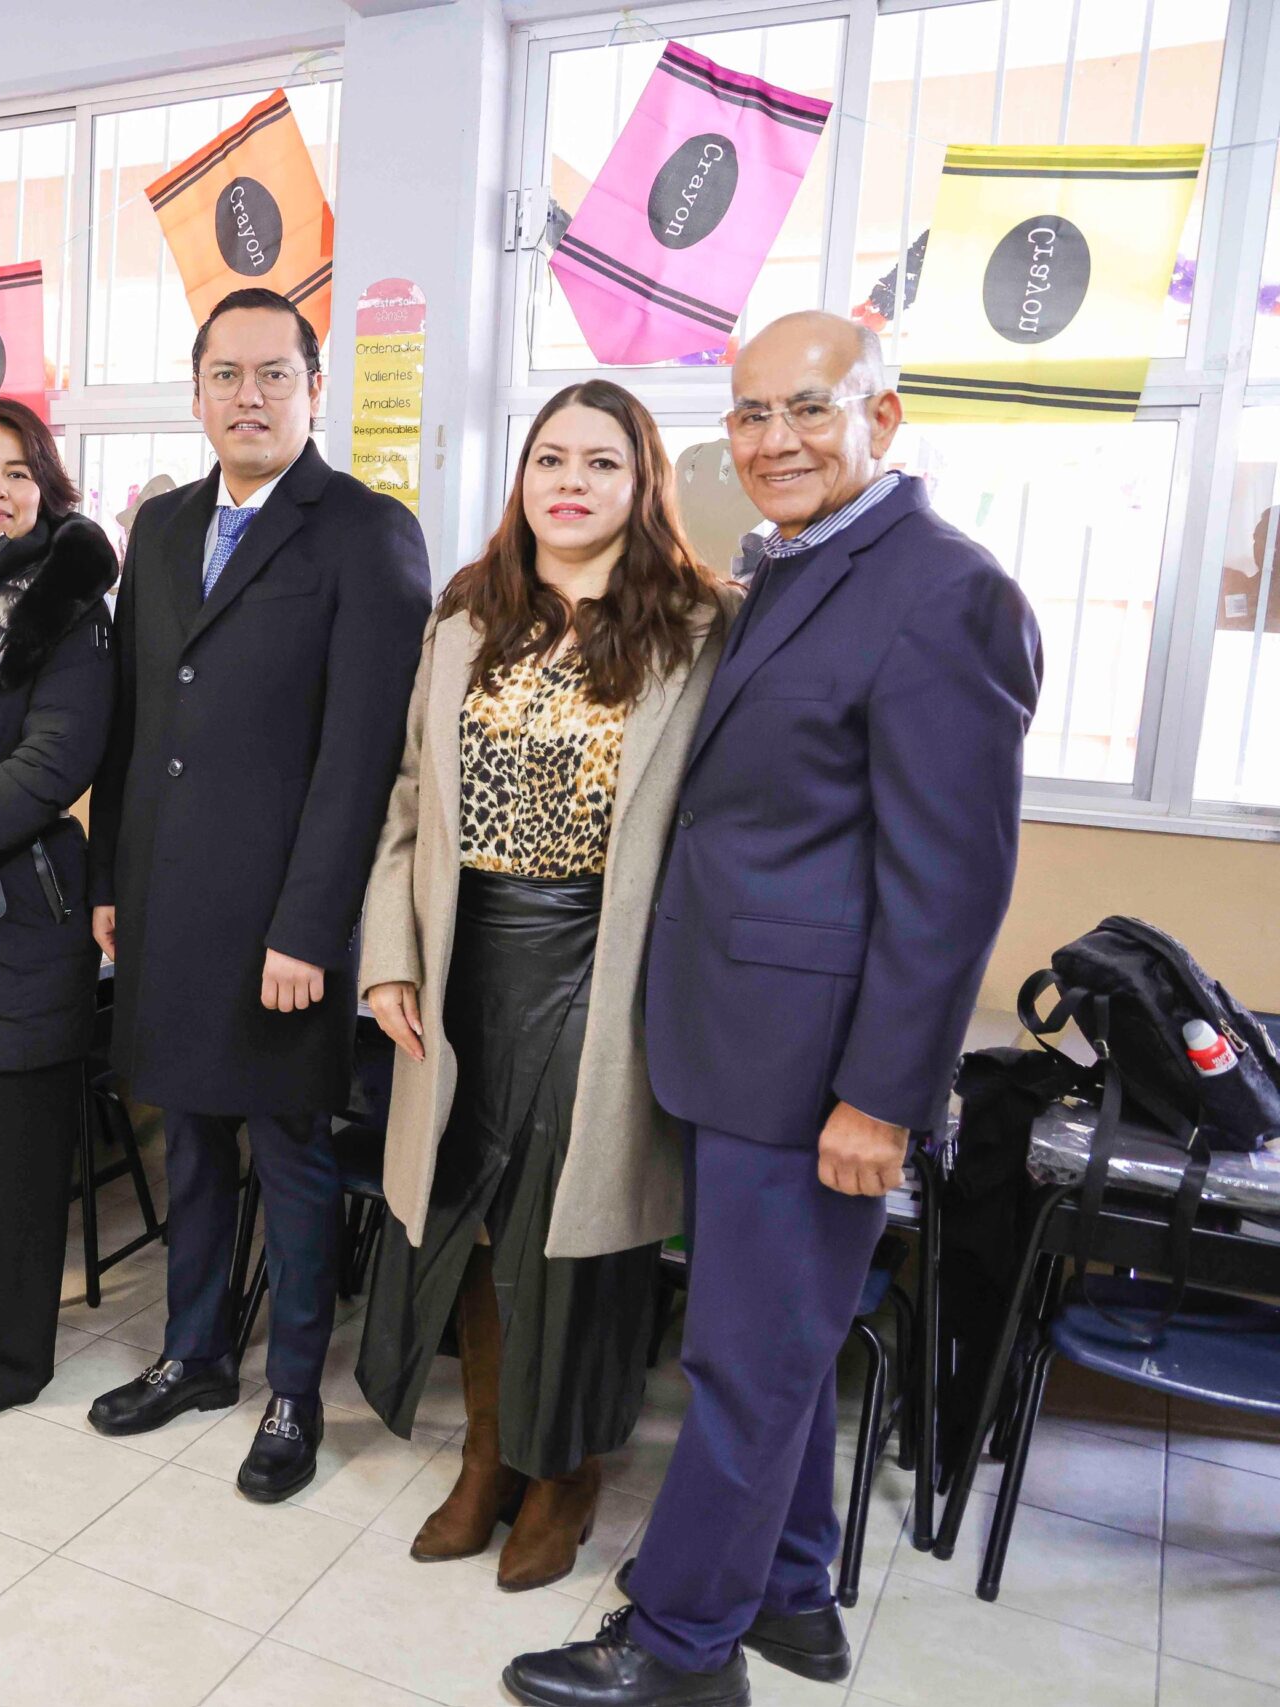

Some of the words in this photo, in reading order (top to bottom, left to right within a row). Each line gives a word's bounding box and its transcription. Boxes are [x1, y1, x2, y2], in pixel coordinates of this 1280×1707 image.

[665, 143, 724, 237] Crayon
[230, 186, 265, 268] Crayon
[364, 369, 413, 382] Valientes
[361, 397, 411, 409] Amables
[353, 425, 419, 436] Responsables
